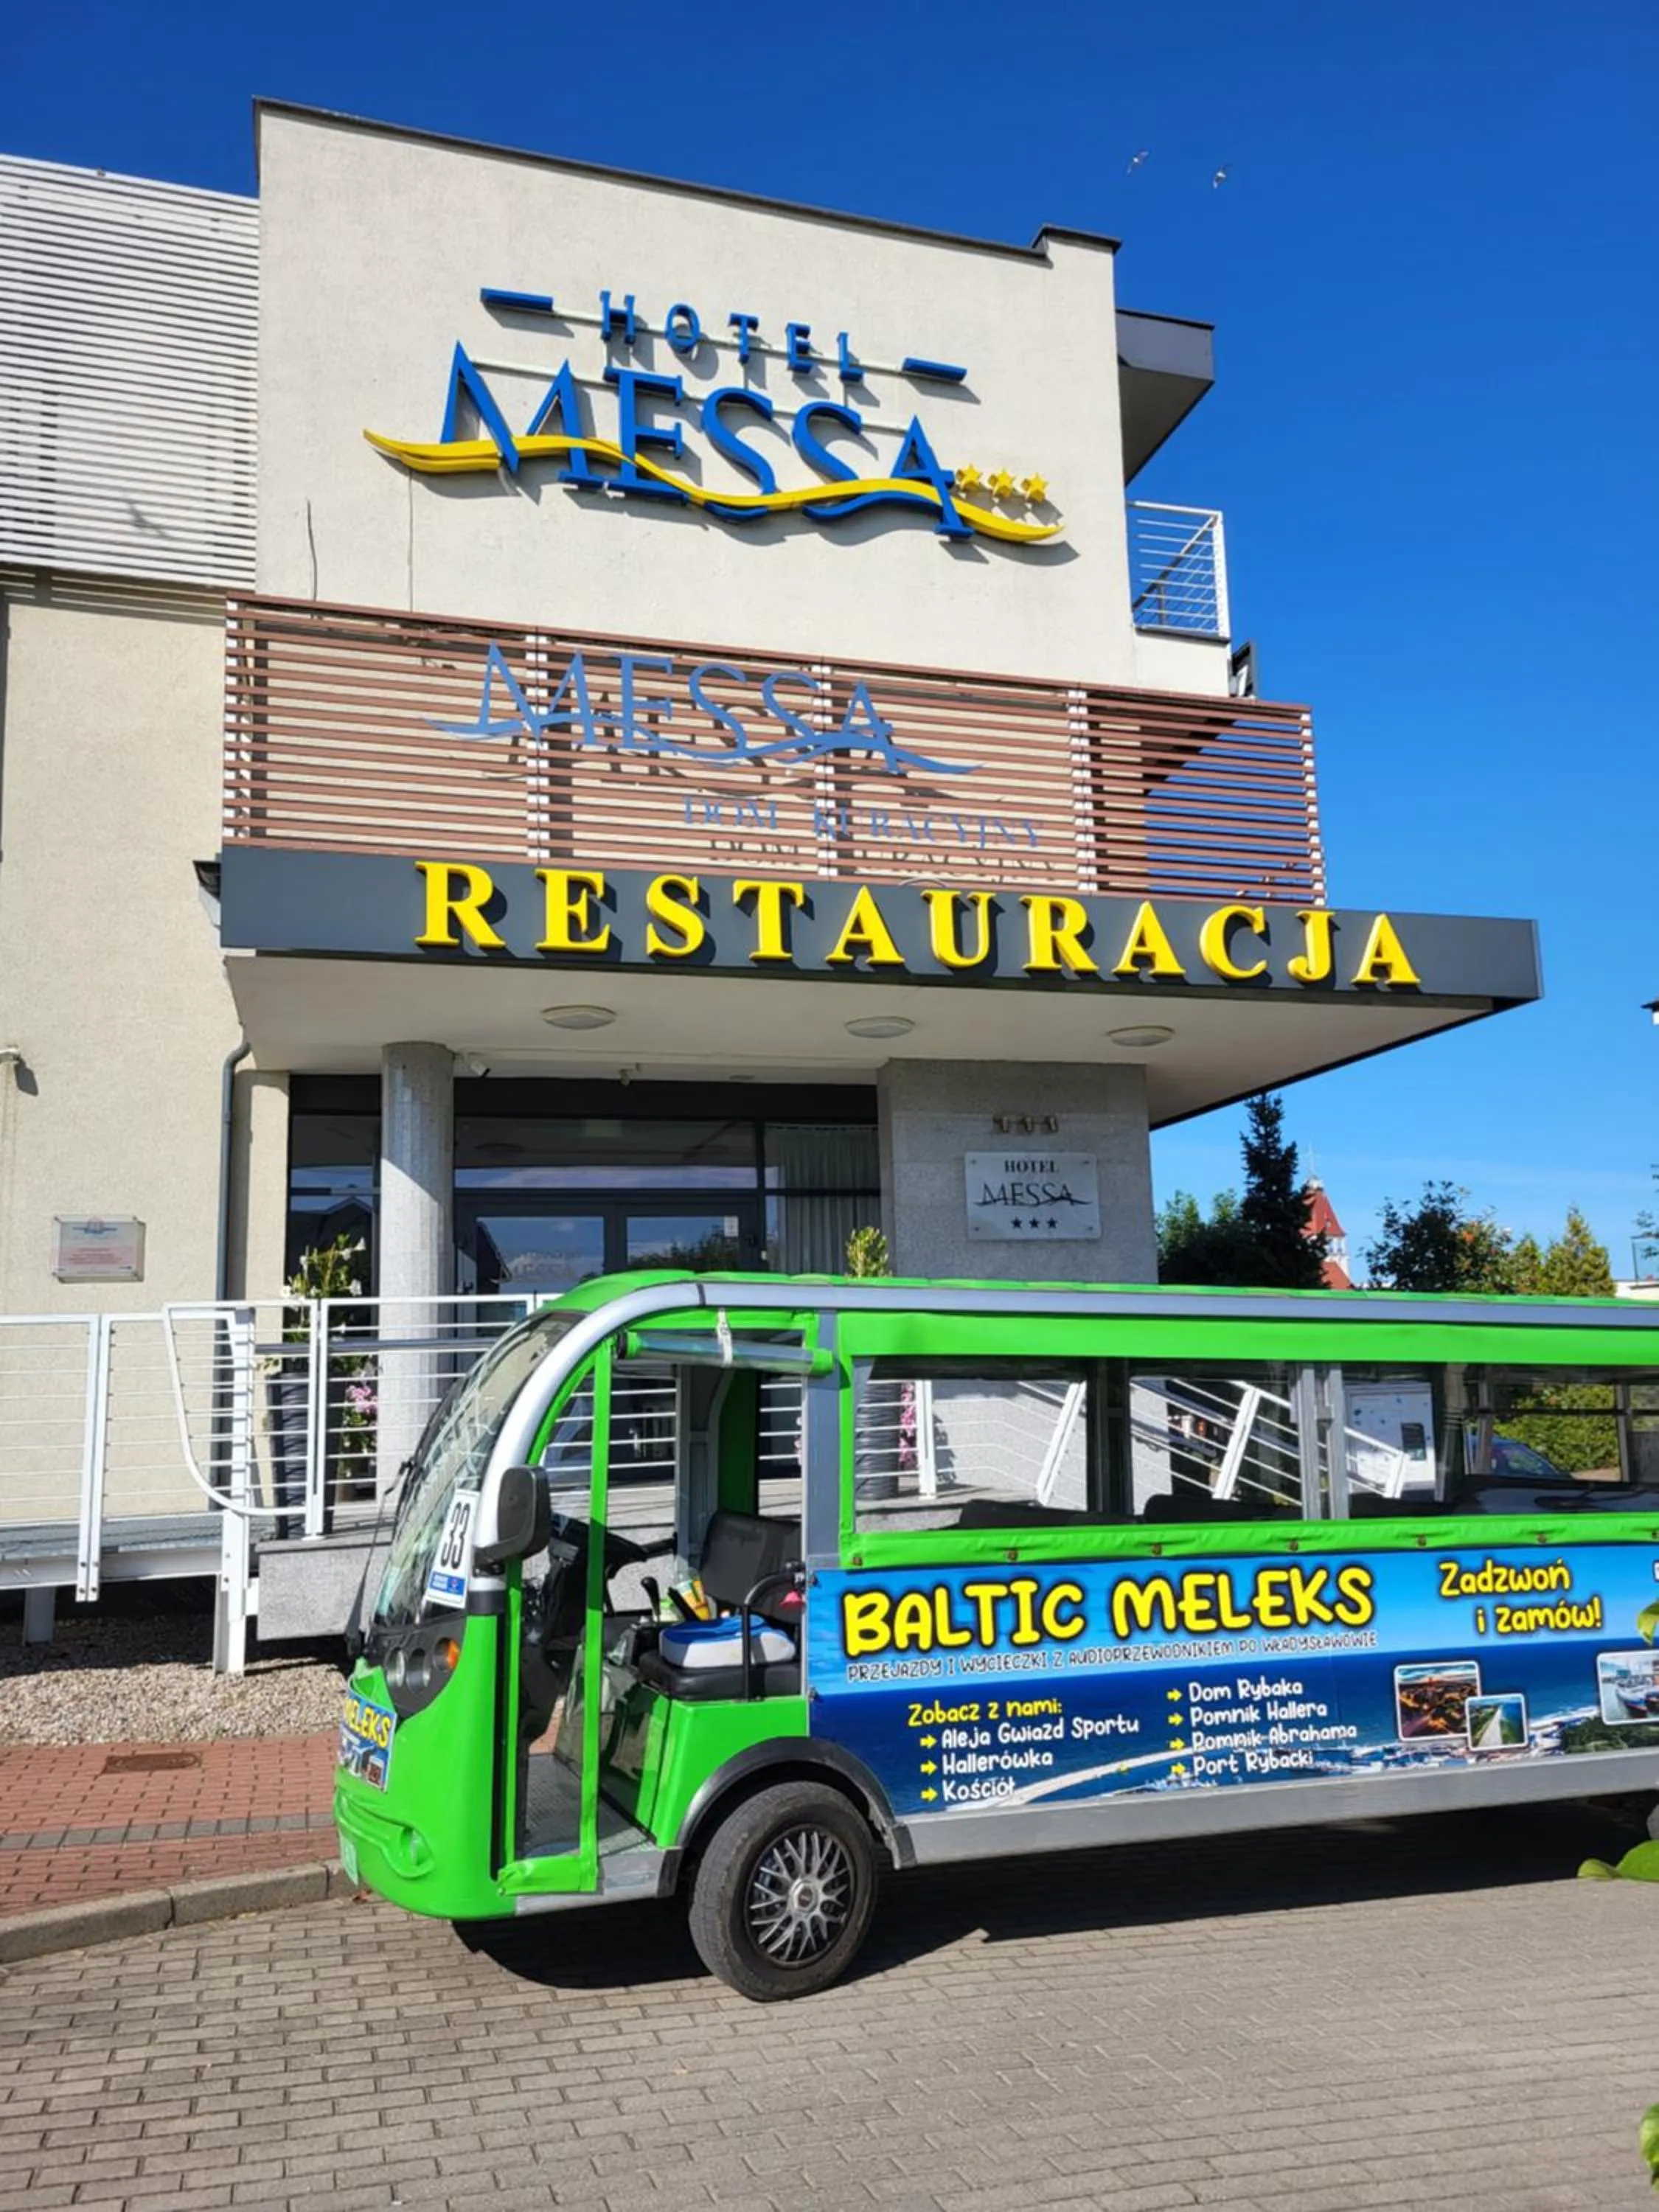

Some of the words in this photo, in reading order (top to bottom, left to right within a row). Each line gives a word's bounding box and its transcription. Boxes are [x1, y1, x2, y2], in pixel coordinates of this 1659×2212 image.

[600, 291, 864, 383] HOTEL
[440, 340, 975, 539] MESSA
[476, 640, 905, 774] MESSA
[414, 860, 1422, 985] RESTAURACJA
[1004, 1159, 1060, 1174] HOTEL
[981, 1181, 1075, 1207] MESSA
[440, 1500, 471, 1570] 33
[1439, 1558, 1571, 1597] Zadzwoń
[843, 1579, 1085, 1657] BALTIC
[1112, 1567, 1374, 1638] MELEKS
[1477, 1609, 1486, 1633] i
[1495, 1596, 1602, 1632] zamów!
[848, 1660, 942, 1681] PRZEJAZDY
[948, 1658, 955, 1675] I
[960, 1651, 1047, 1673] WYCIECZKI
[1052, 1651, 1062, 1668] Z
[1068, 1641, 1234, 1664] AUDIOPRZEWODNIKIEM
[1239, 1638, 1257, 1653] PO
[1189, 1681, 1231, 1703] Dom
[1237, 1675, 1304, 1701] Rybaka
[908, 1700, 981, 1727] Zobacz
[987, 1702, 999, 1719] z
[1006, 1698, 1062, 1717] nami:
[1189, 1705, 1260, 1728] Pomnik
[1267, 1700, 1328, 1721] Hallera
[941, 1727, 991, 1749] Aleja
[998, 1717, 1064, 1743] Gwiazd
[1071, 1714, 1140, 1740] Sportu
[1269, 1723, 1357, 1745] Abrahama
[942, 1748, 1054, 1775] Hallerówka
[1193, 1755, 1239, 1776] Port
[1245, 1750, 1314, 1775] Rybacki
[942, 1776, 1016, 1802] Kościół
